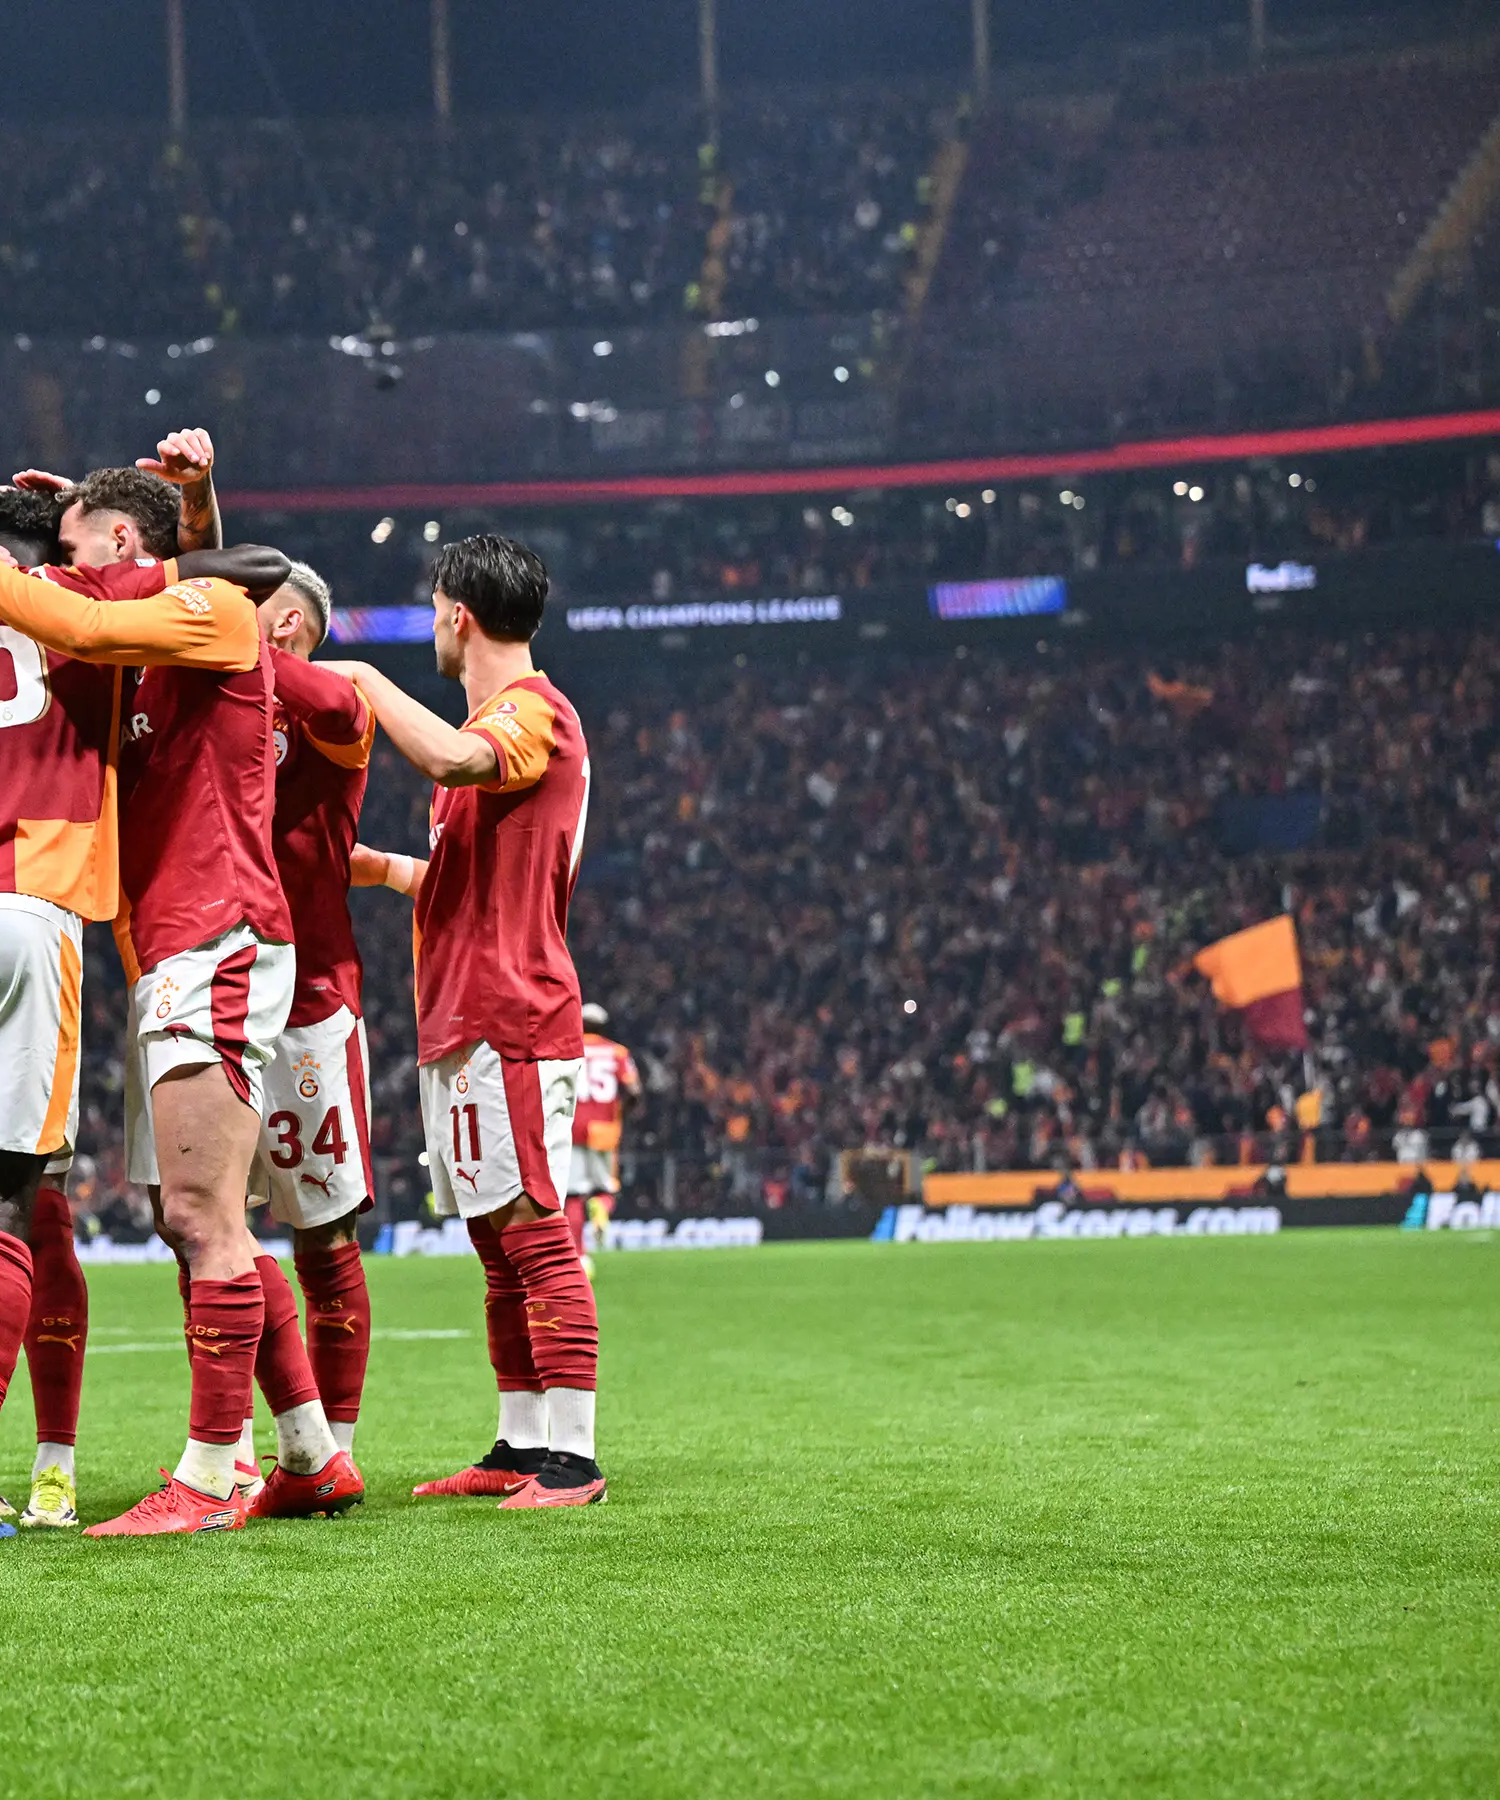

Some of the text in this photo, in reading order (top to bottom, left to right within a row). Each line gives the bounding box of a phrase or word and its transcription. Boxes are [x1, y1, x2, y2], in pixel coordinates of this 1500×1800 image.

[626, 600, 756, 630] CHAMPIONS
[268, 1105, 348, 1169] 34
[449, 1103, 483, 1163] 11
[195, 1325, 220, 1338] GS
